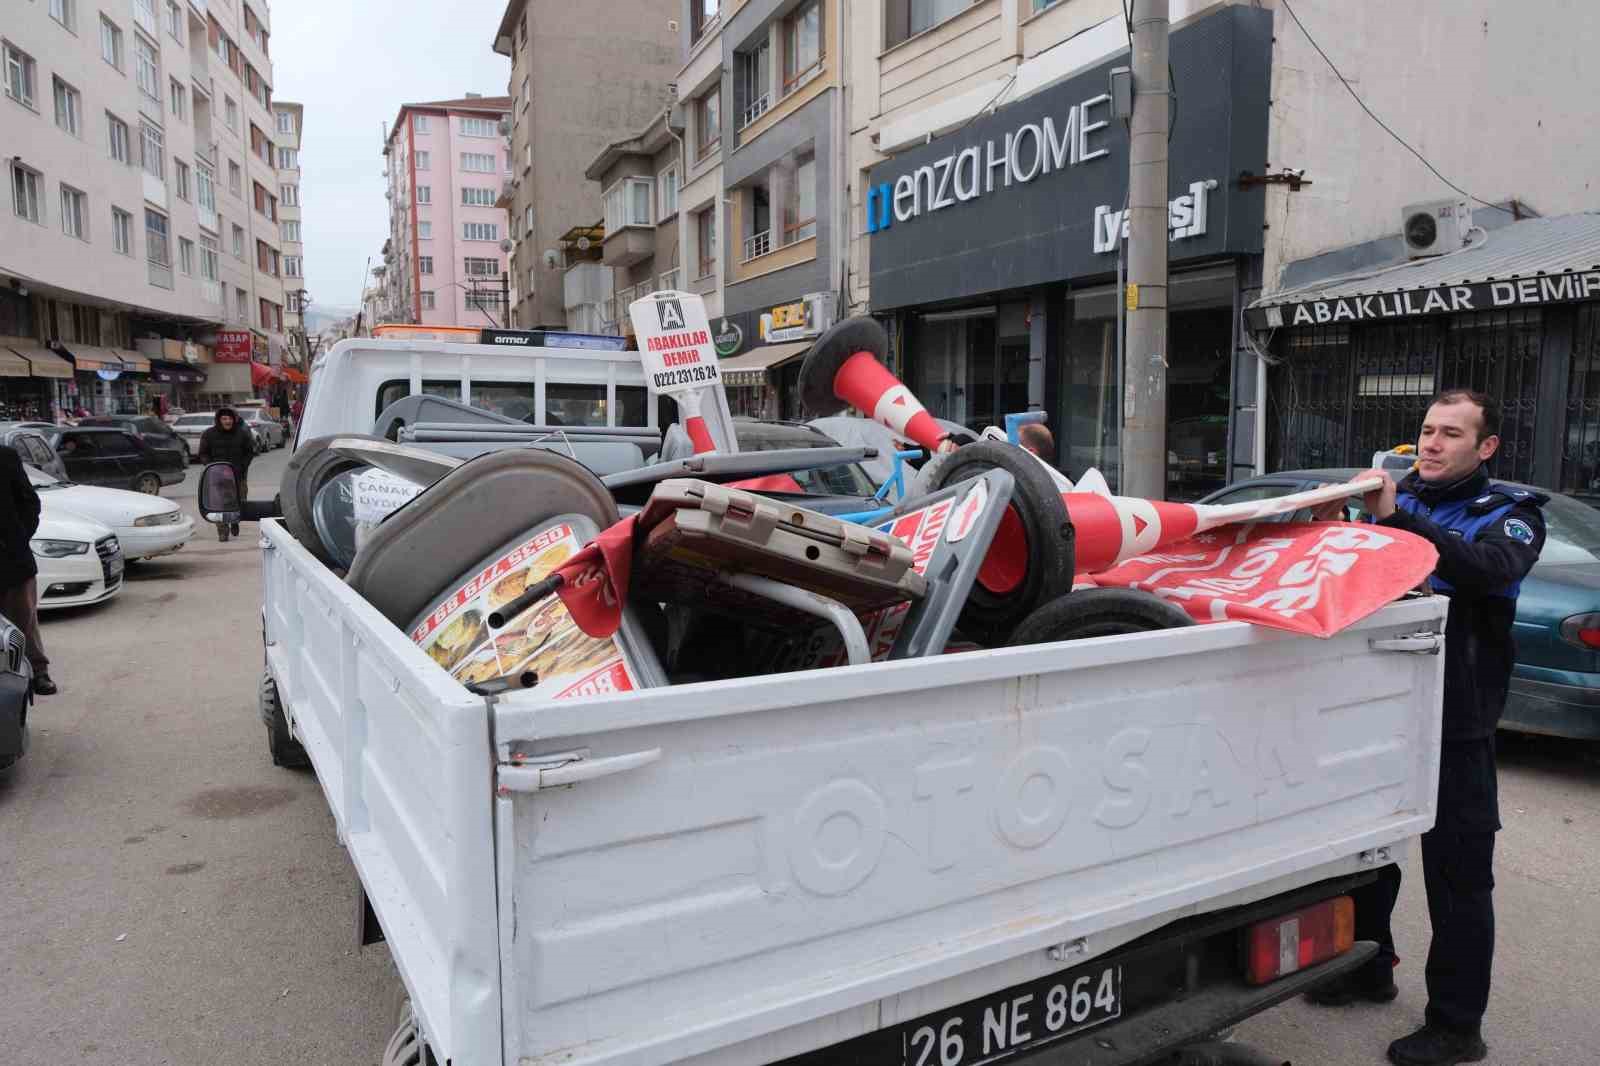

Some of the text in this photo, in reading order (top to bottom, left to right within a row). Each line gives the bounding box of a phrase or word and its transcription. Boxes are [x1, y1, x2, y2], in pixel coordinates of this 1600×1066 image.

[1293, 286, 1475, 325] ABAKLILAR
[495, 336, 529, 345] armas
[647, 330, 709, 352] ABAKLILAR
[654, 364, 718, 387] 0222 231 26 24
[910, 968, 1115, 1066] 26 NE 864
